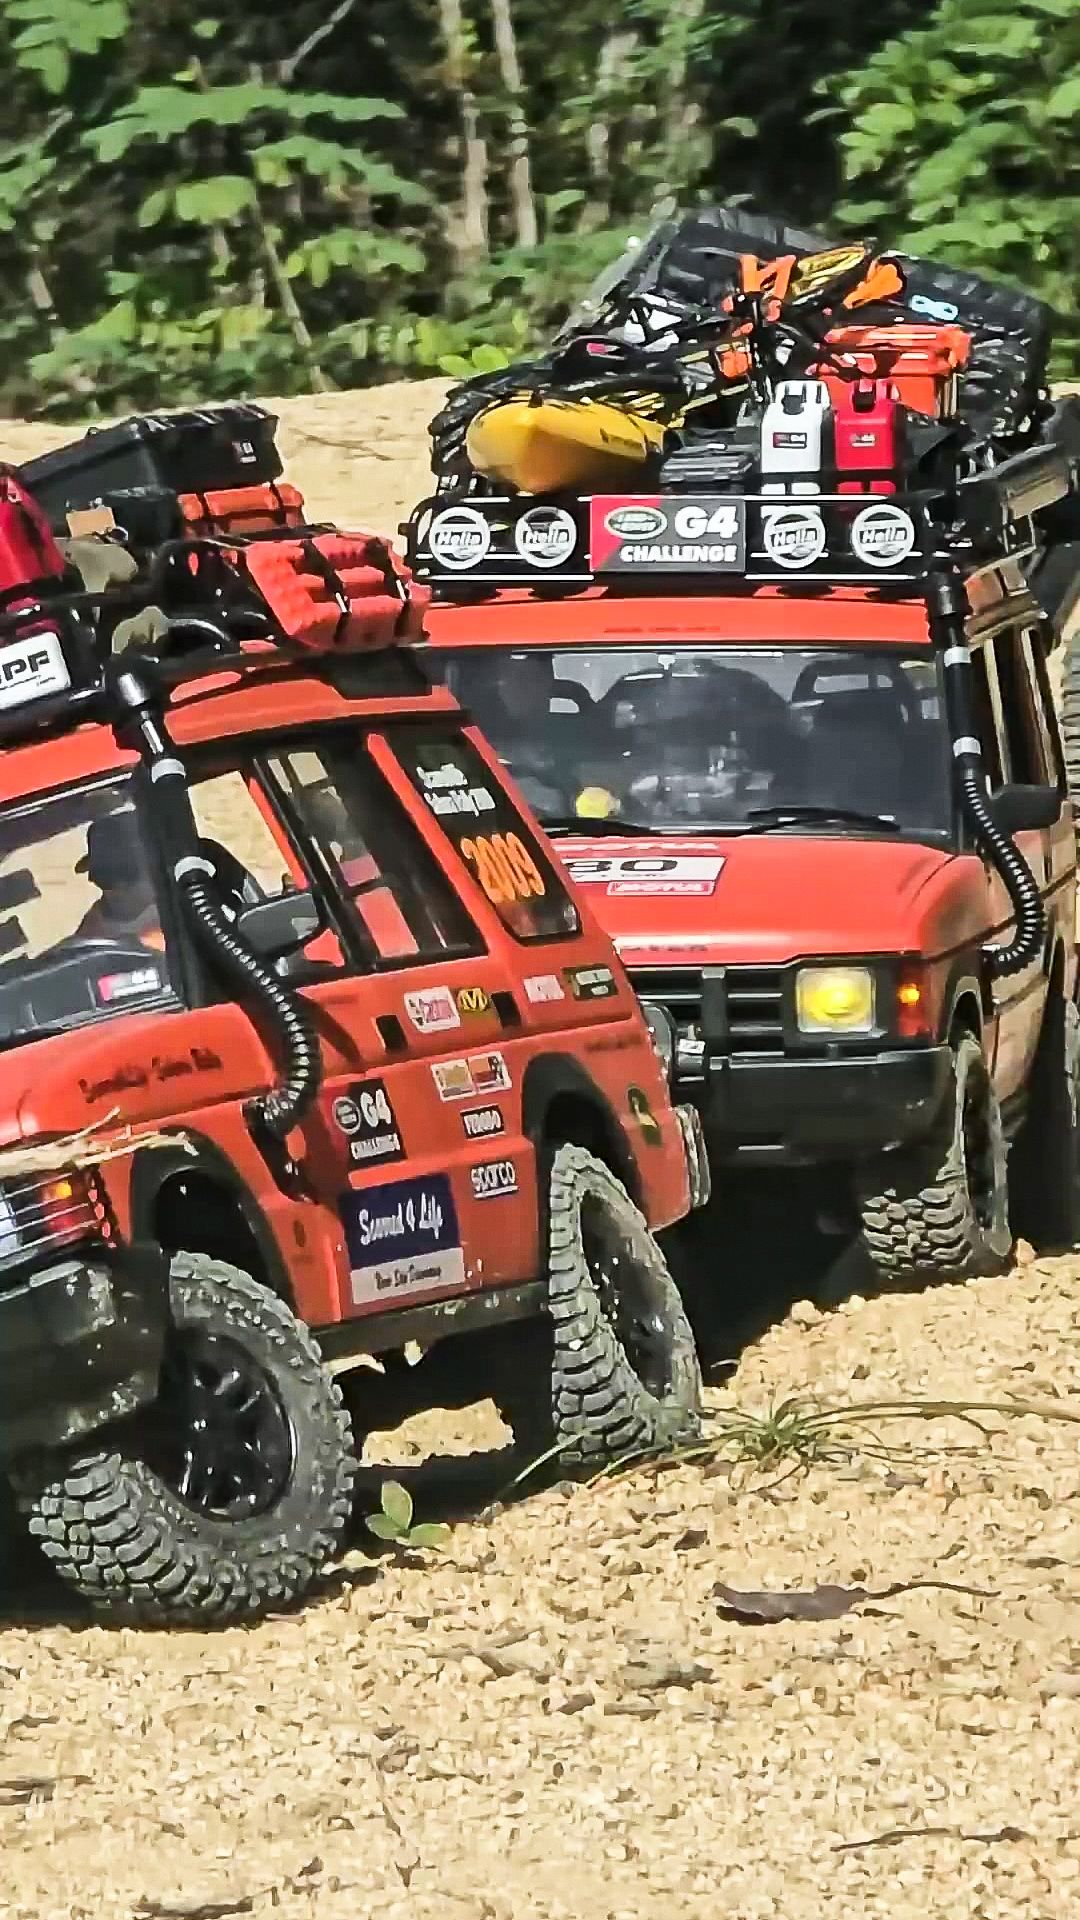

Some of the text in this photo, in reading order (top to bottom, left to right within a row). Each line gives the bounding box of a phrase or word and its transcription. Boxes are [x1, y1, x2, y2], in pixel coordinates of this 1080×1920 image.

[674, 505, 739, 539] G4
[619, 544, 738, 563] CHALLENGE
[0, 649, 51, 685] PF
